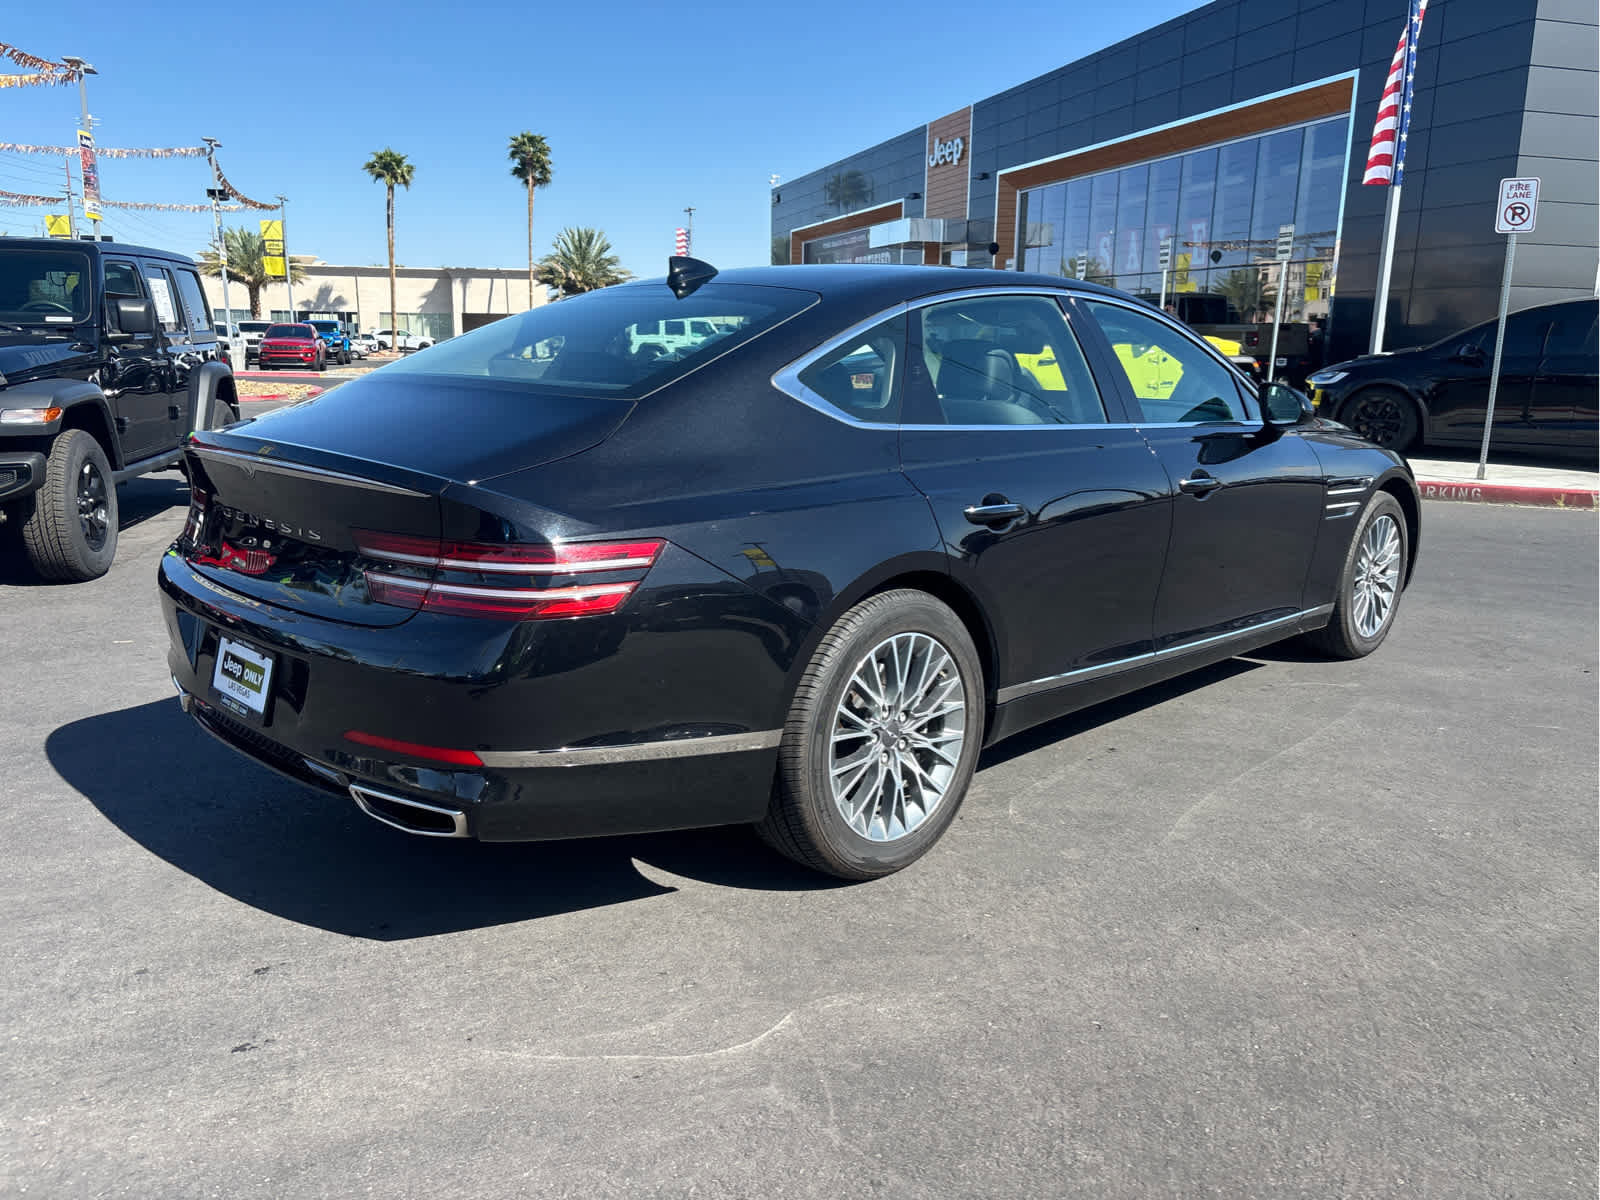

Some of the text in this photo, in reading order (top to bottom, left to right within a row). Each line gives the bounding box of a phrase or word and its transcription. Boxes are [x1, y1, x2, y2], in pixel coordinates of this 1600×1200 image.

[929, 137, 964, 167] Jeep
[1506, 191, 1532, 199] LANE
[223, 508, 321, 540] GENESIS
[223, 655, 264, 688] Jeep ONLY
